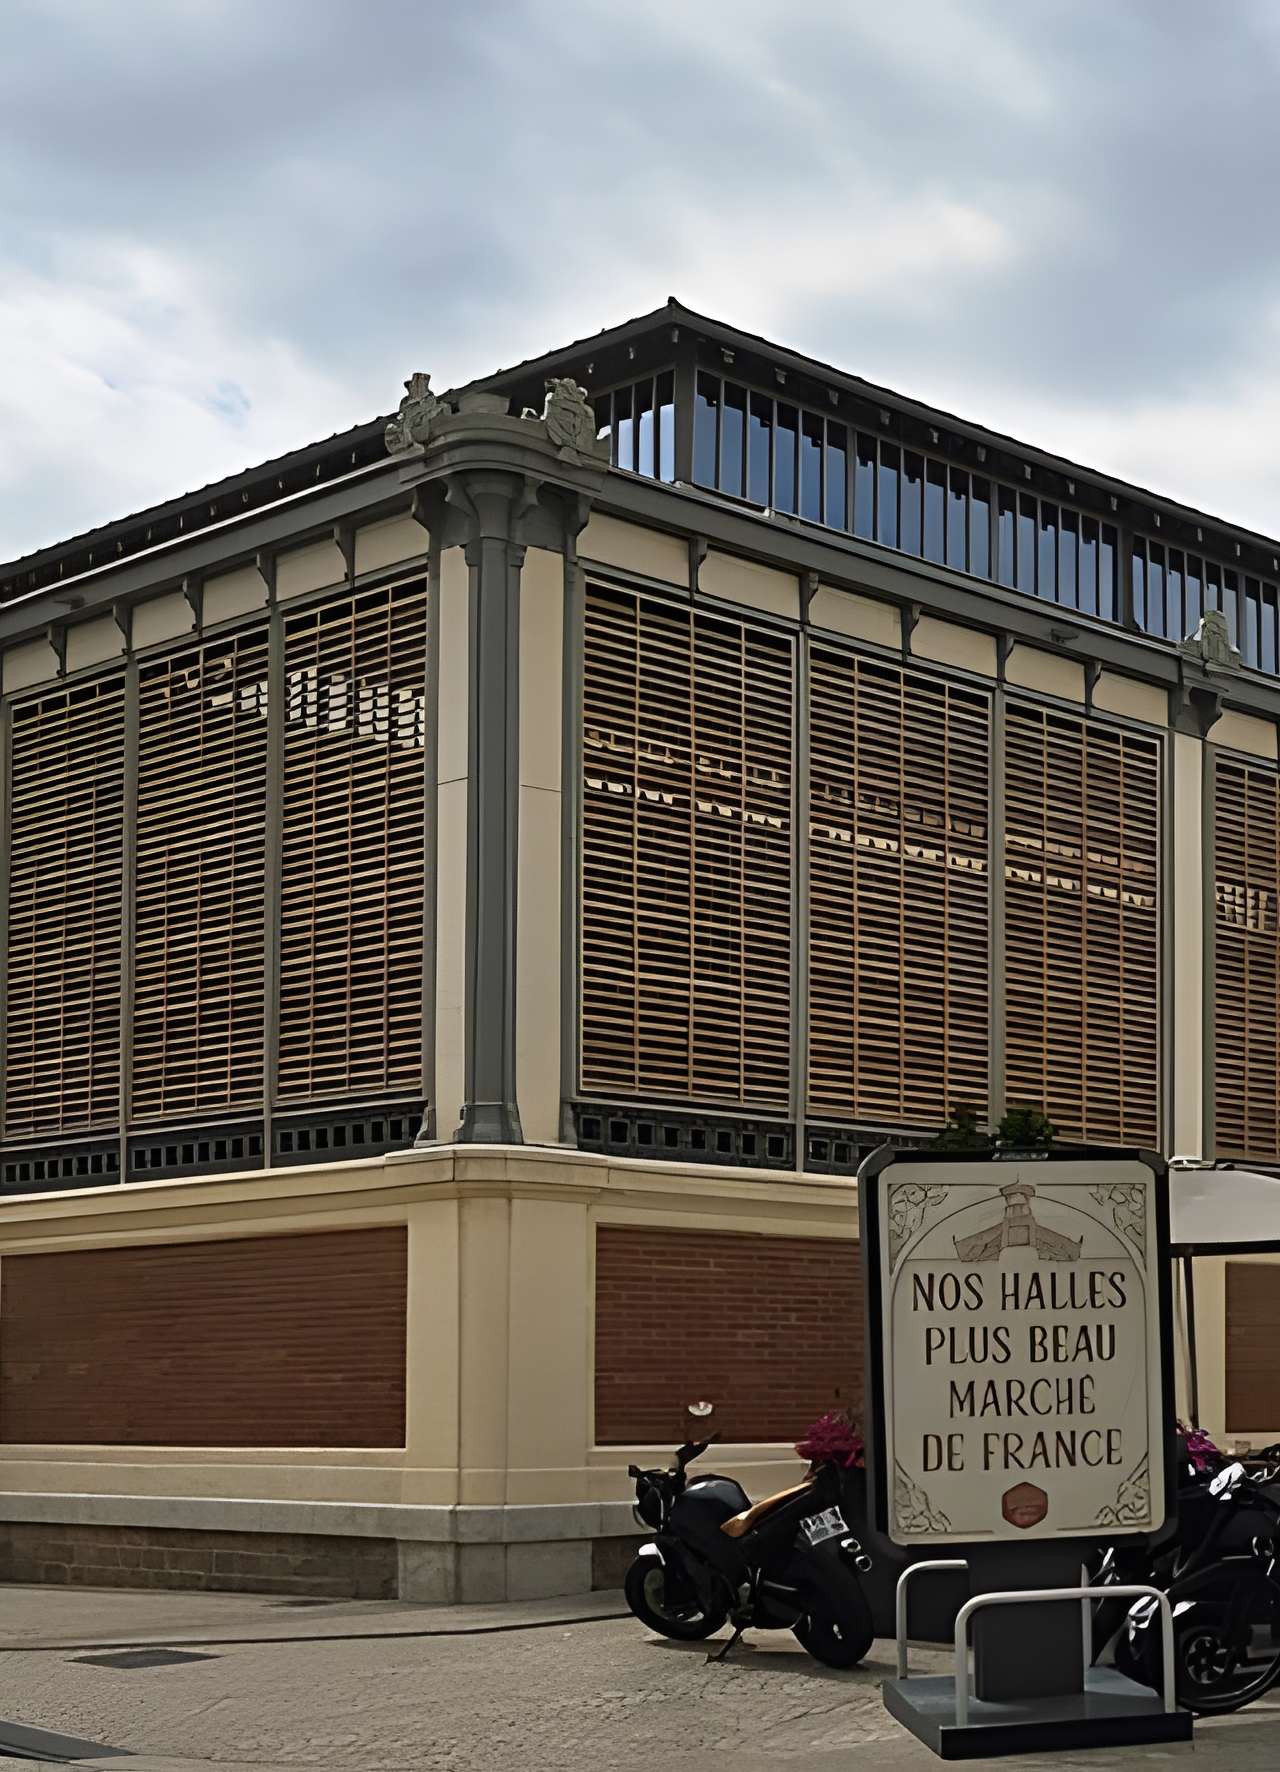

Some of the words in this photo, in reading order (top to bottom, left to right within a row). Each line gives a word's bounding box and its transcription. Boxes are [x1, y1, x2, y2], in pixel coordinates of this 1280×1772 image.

[912, 1272, 984, 1312] NOS
[1001, 1271, 1127, 1311] HALLES
[925, 1326, 1012, 1366] PLUS
[1029, 1324, 1116, 1363] BEAU
[922, 1433, 965, 1473] DE
[983, 1428, 1123, 1471] FRANCE
